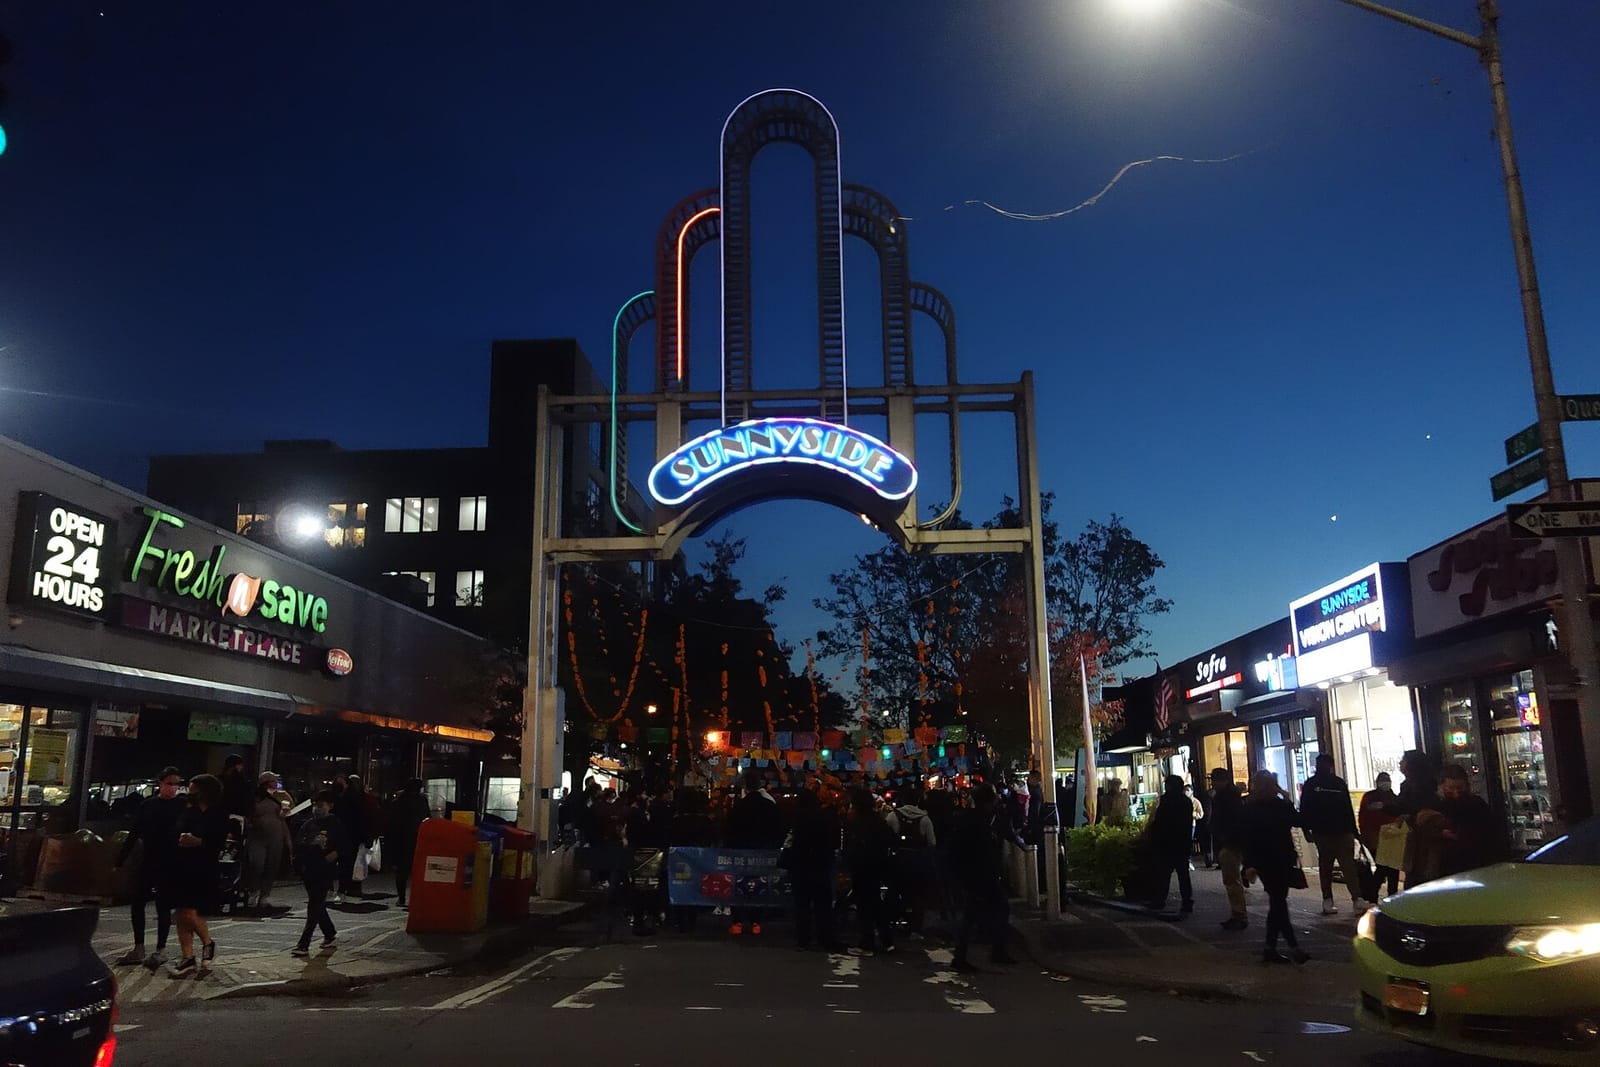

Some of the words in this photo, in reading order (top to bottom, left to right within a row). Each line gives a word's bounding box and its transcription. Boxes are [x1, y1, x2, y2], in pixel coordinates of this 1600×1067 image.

[669, 424, 894, 487] SUNNYSIDE
[50, 507, 105, 547] OPEN
[1527, 513, 1562, 527] ONE
[44, 535, 100, 584] 24
[131, 506, 226, 607] Fresh
[259, 579, 328, 633] save
[33, 571, 104, 612] HOURS
[1320, 580, 1370, 615] SUNNYSIDE
[148, 605, 302, 664] MARKETPLACE
[1196, 653, 1227, 682] Sofra
